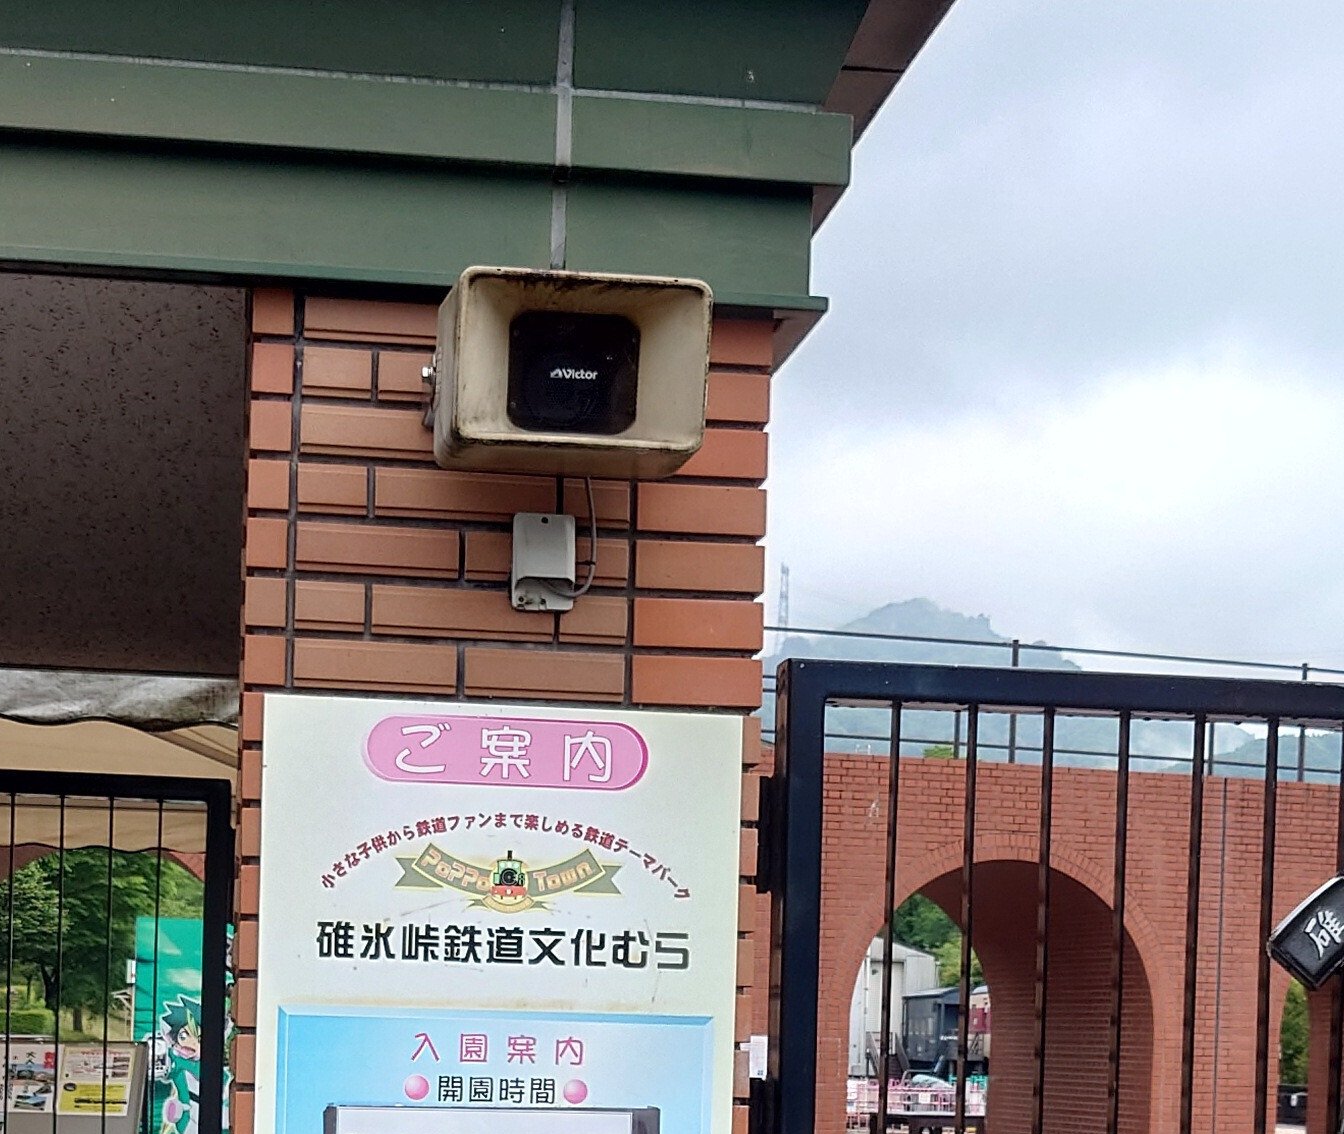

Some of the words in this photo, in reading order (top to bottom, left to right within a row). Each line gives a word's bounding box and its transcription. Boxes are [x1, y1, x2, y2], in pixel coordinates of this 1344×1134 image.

[562, 367, 598, 380] Victor
[395, 721, 613, 784] ご案内
[320, 811, 692, 901] 小さな子供から鉄道ファンまで楽しめる鉄道テーマパーク
[315, 919, 691, 971] 碓氷峠鉄道文化むら
[409, 1032, 585, 1067] 入園案内
[437, 1075, 557, 1105] 開園時間
